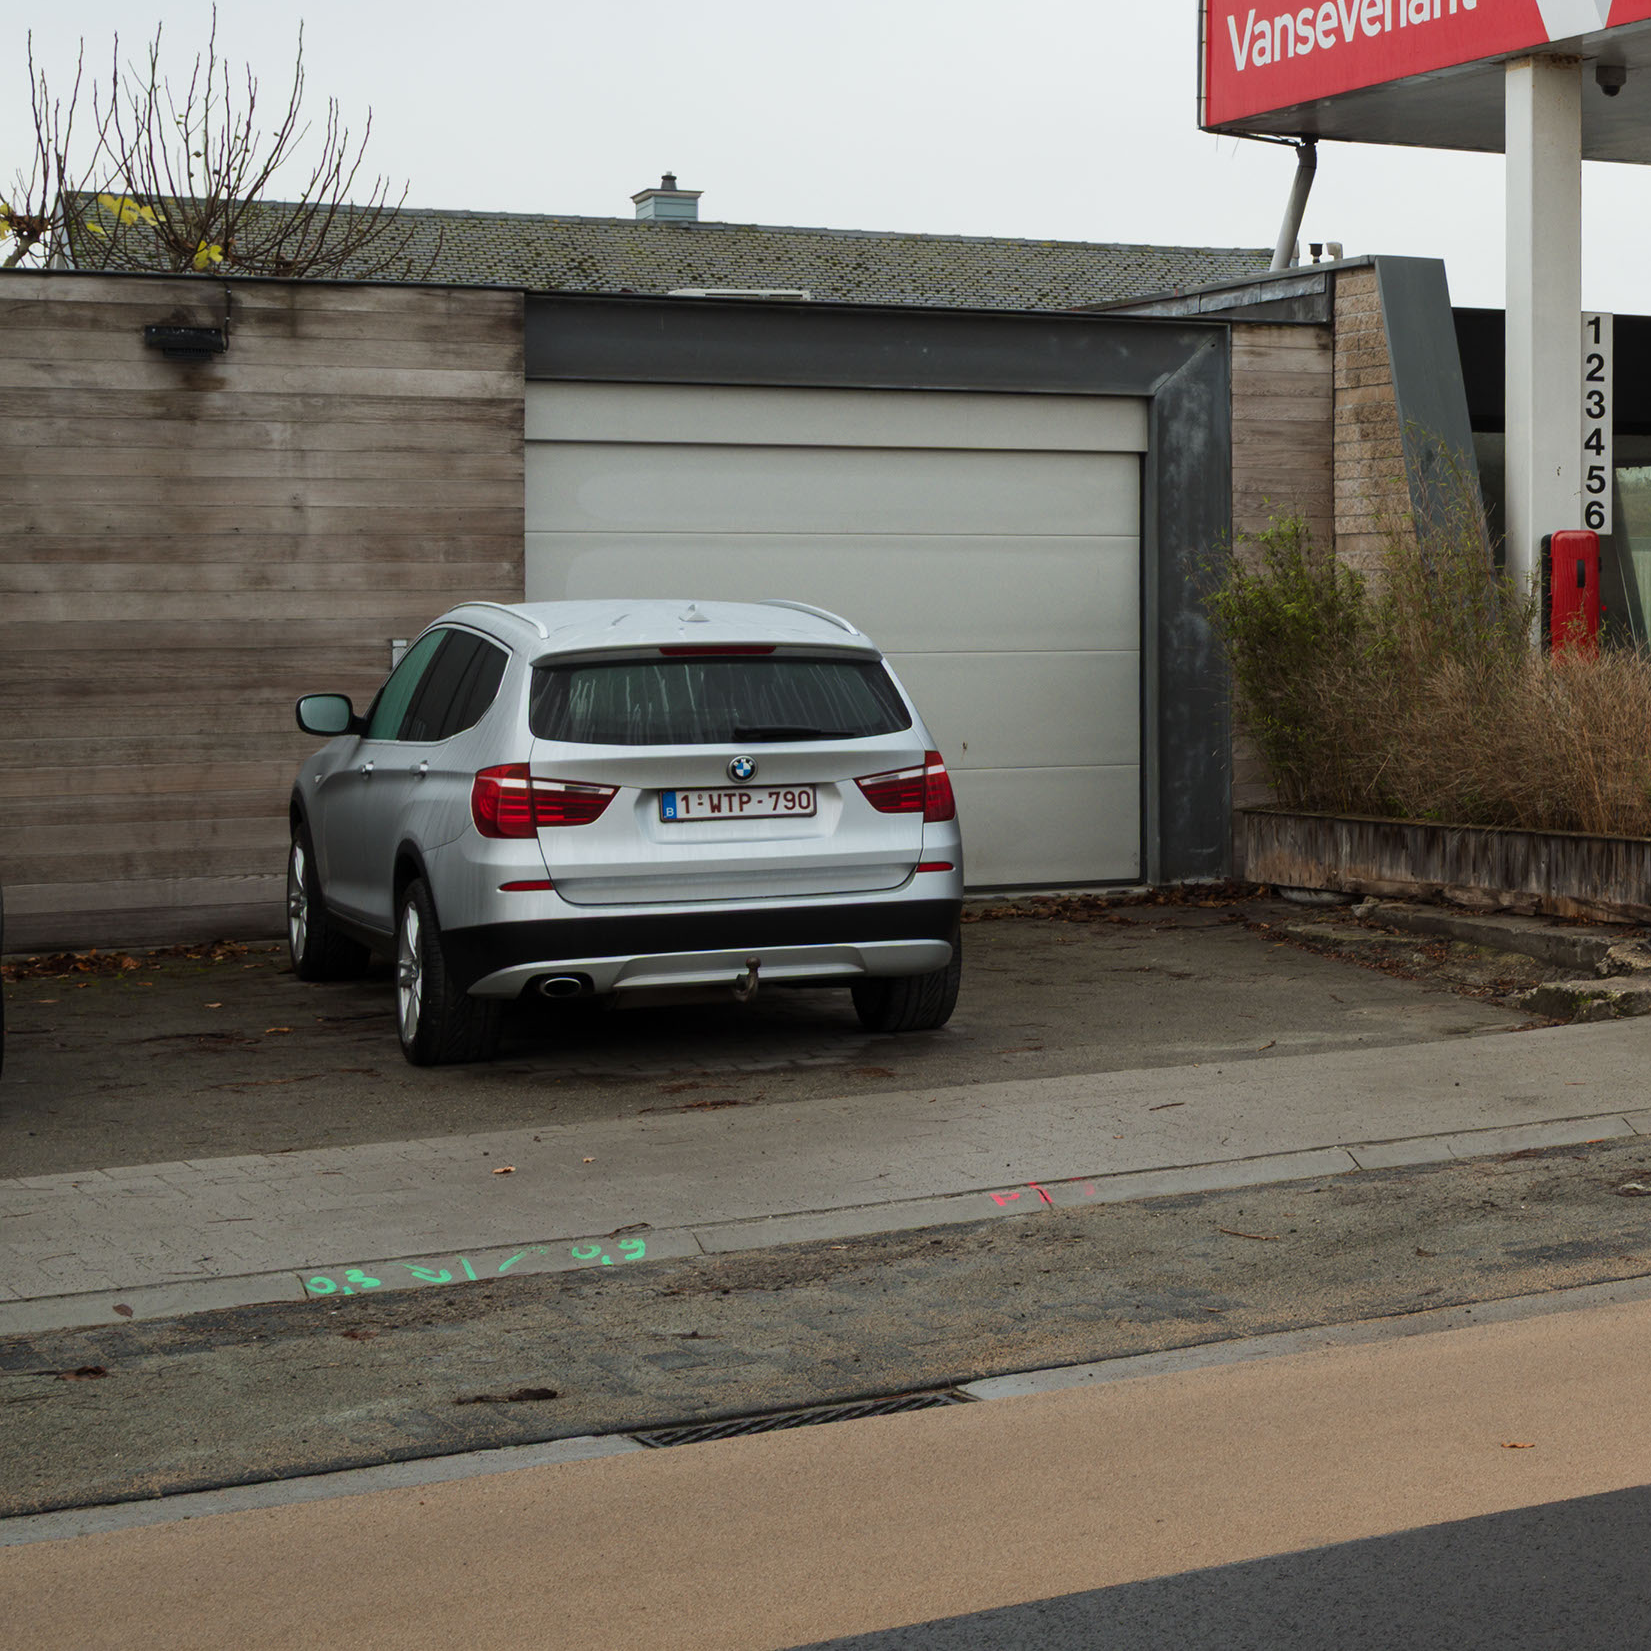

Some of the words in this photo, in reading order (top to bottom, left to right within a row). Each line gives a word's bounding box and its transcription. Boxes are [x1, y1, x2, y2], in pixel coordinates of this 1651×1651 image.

[1587, 316, 1601, 344] 1
[1585, 353, 1605, 382] 2
[1585, 390, 1605, 419] 3
[1584, 428, 1605, 456] 4
[1585, 465, 1606, 494] 5
[1584, 501, 1604, 530] 6
[665, 807, 674, 817] B
